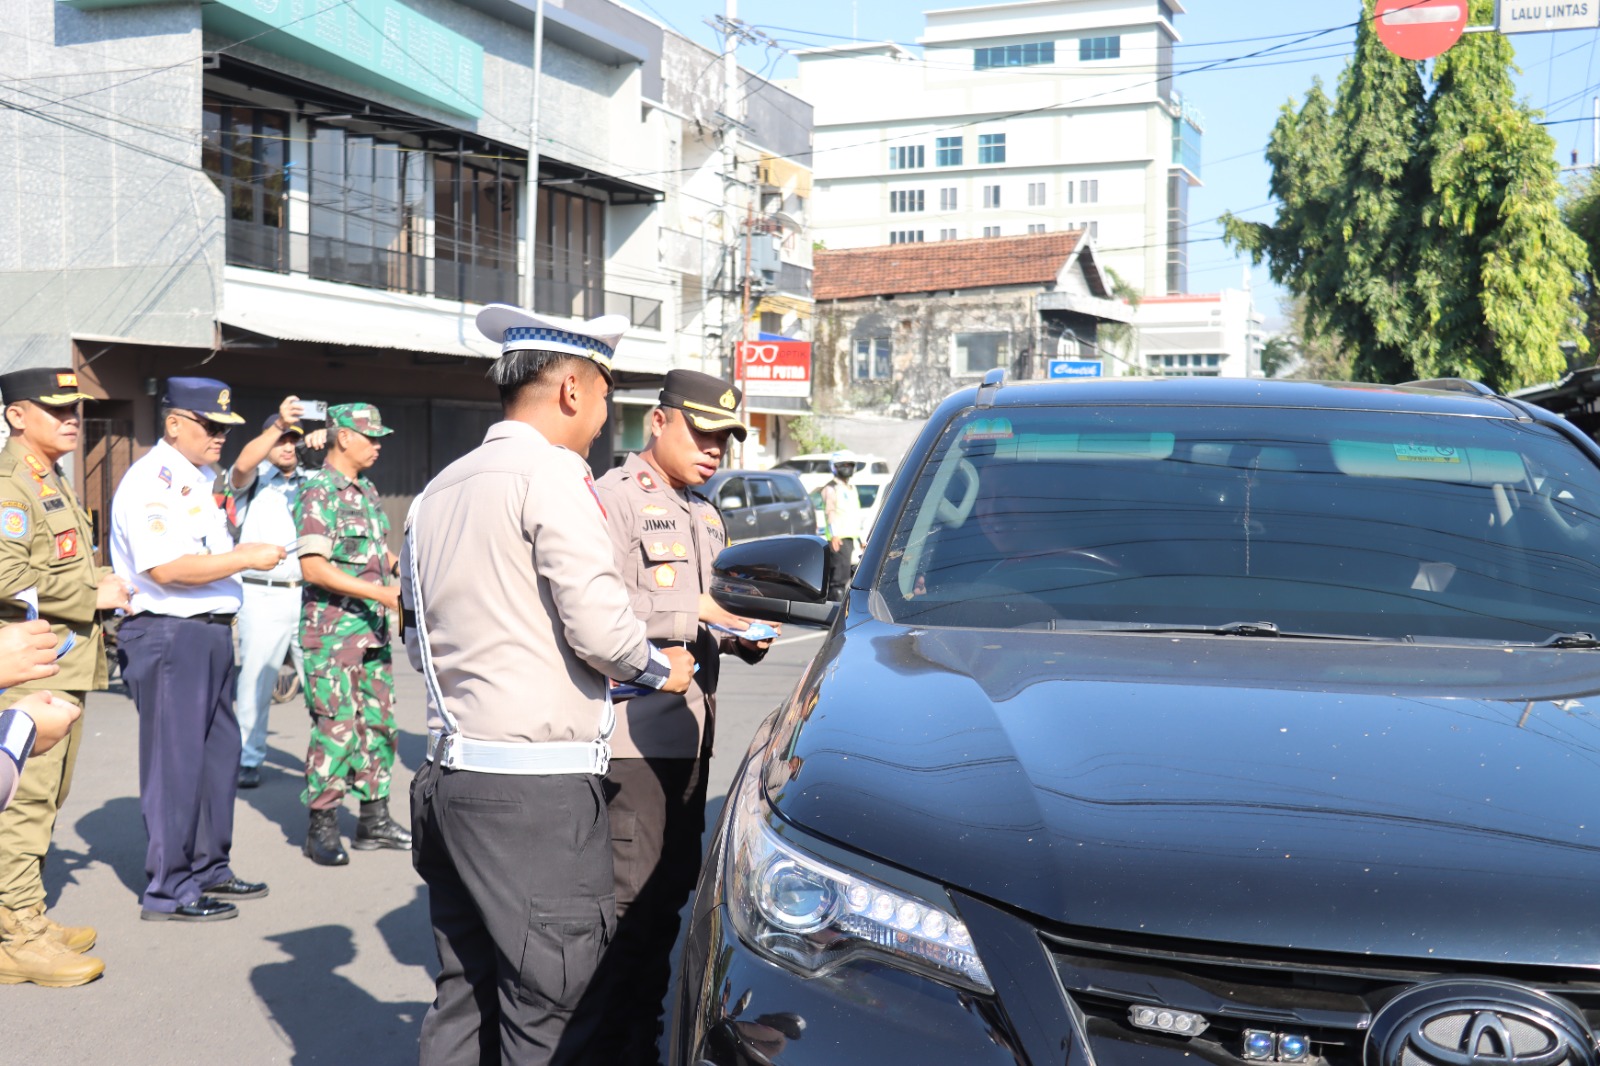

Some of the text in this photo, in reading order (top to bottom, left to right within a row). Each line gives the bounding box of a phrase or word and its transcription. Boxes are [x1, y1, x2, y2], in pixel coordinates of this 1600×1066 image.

[1511, 3, 1588, 20] LALU LINTAS
[779, 350, 806, 358] OPTIK
[740, 365, 804, 379] INAR PUTRA
[642, 519, 677, 531] JIMMY
